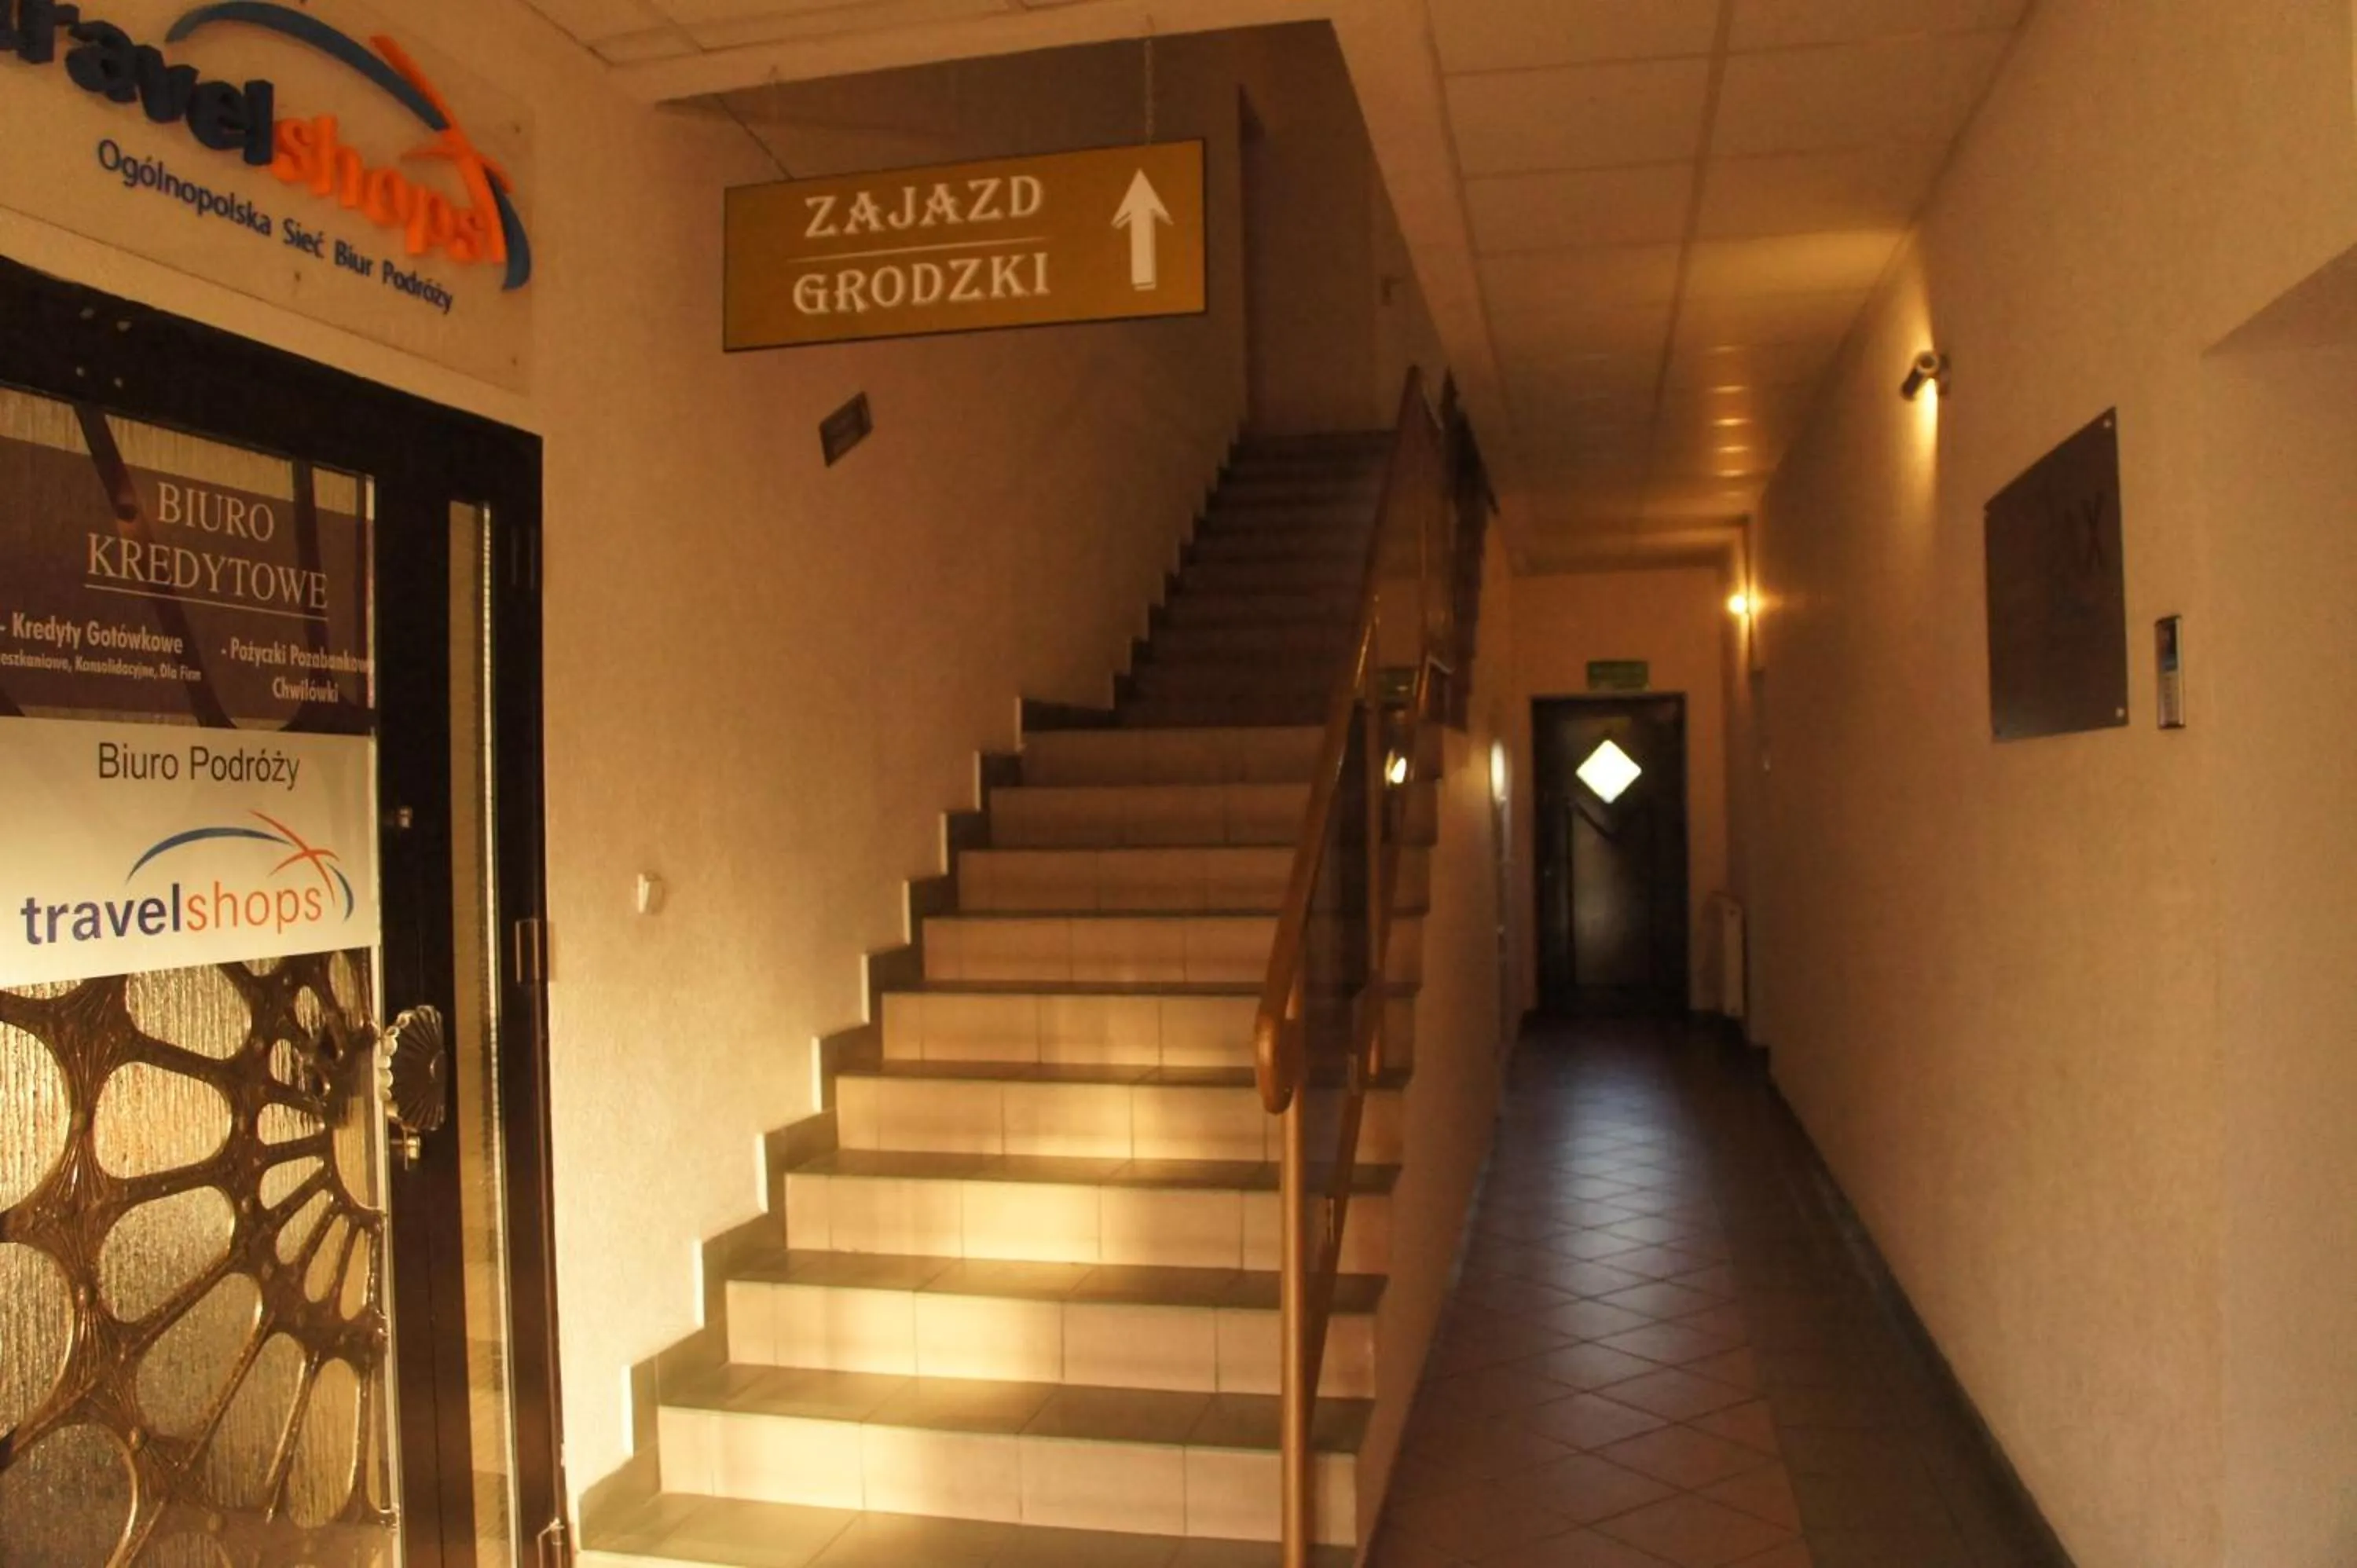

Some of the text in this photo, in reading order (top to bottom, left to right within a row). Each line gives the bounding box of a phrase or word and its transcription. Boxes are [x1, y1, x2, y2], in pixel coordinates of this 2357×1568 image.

[97, 139, 454, 314] Ogólnopolska Sieć Biur Podróży
[803, 174, 1045, 239] ZAJAZD
[792, 251, 1051, 316] GRODZKI
[158, 482, 275, 542] BIURO
[86, 533, 328, 610] KREDYTOWE
[12, 611, 184, 655] Kredyty Gotówkowe
[230, 637, 286, 668] Pożyczki
[98, 742, 300, 791] Biuro Podróży
[20, 880, 324, 945] travelshops
